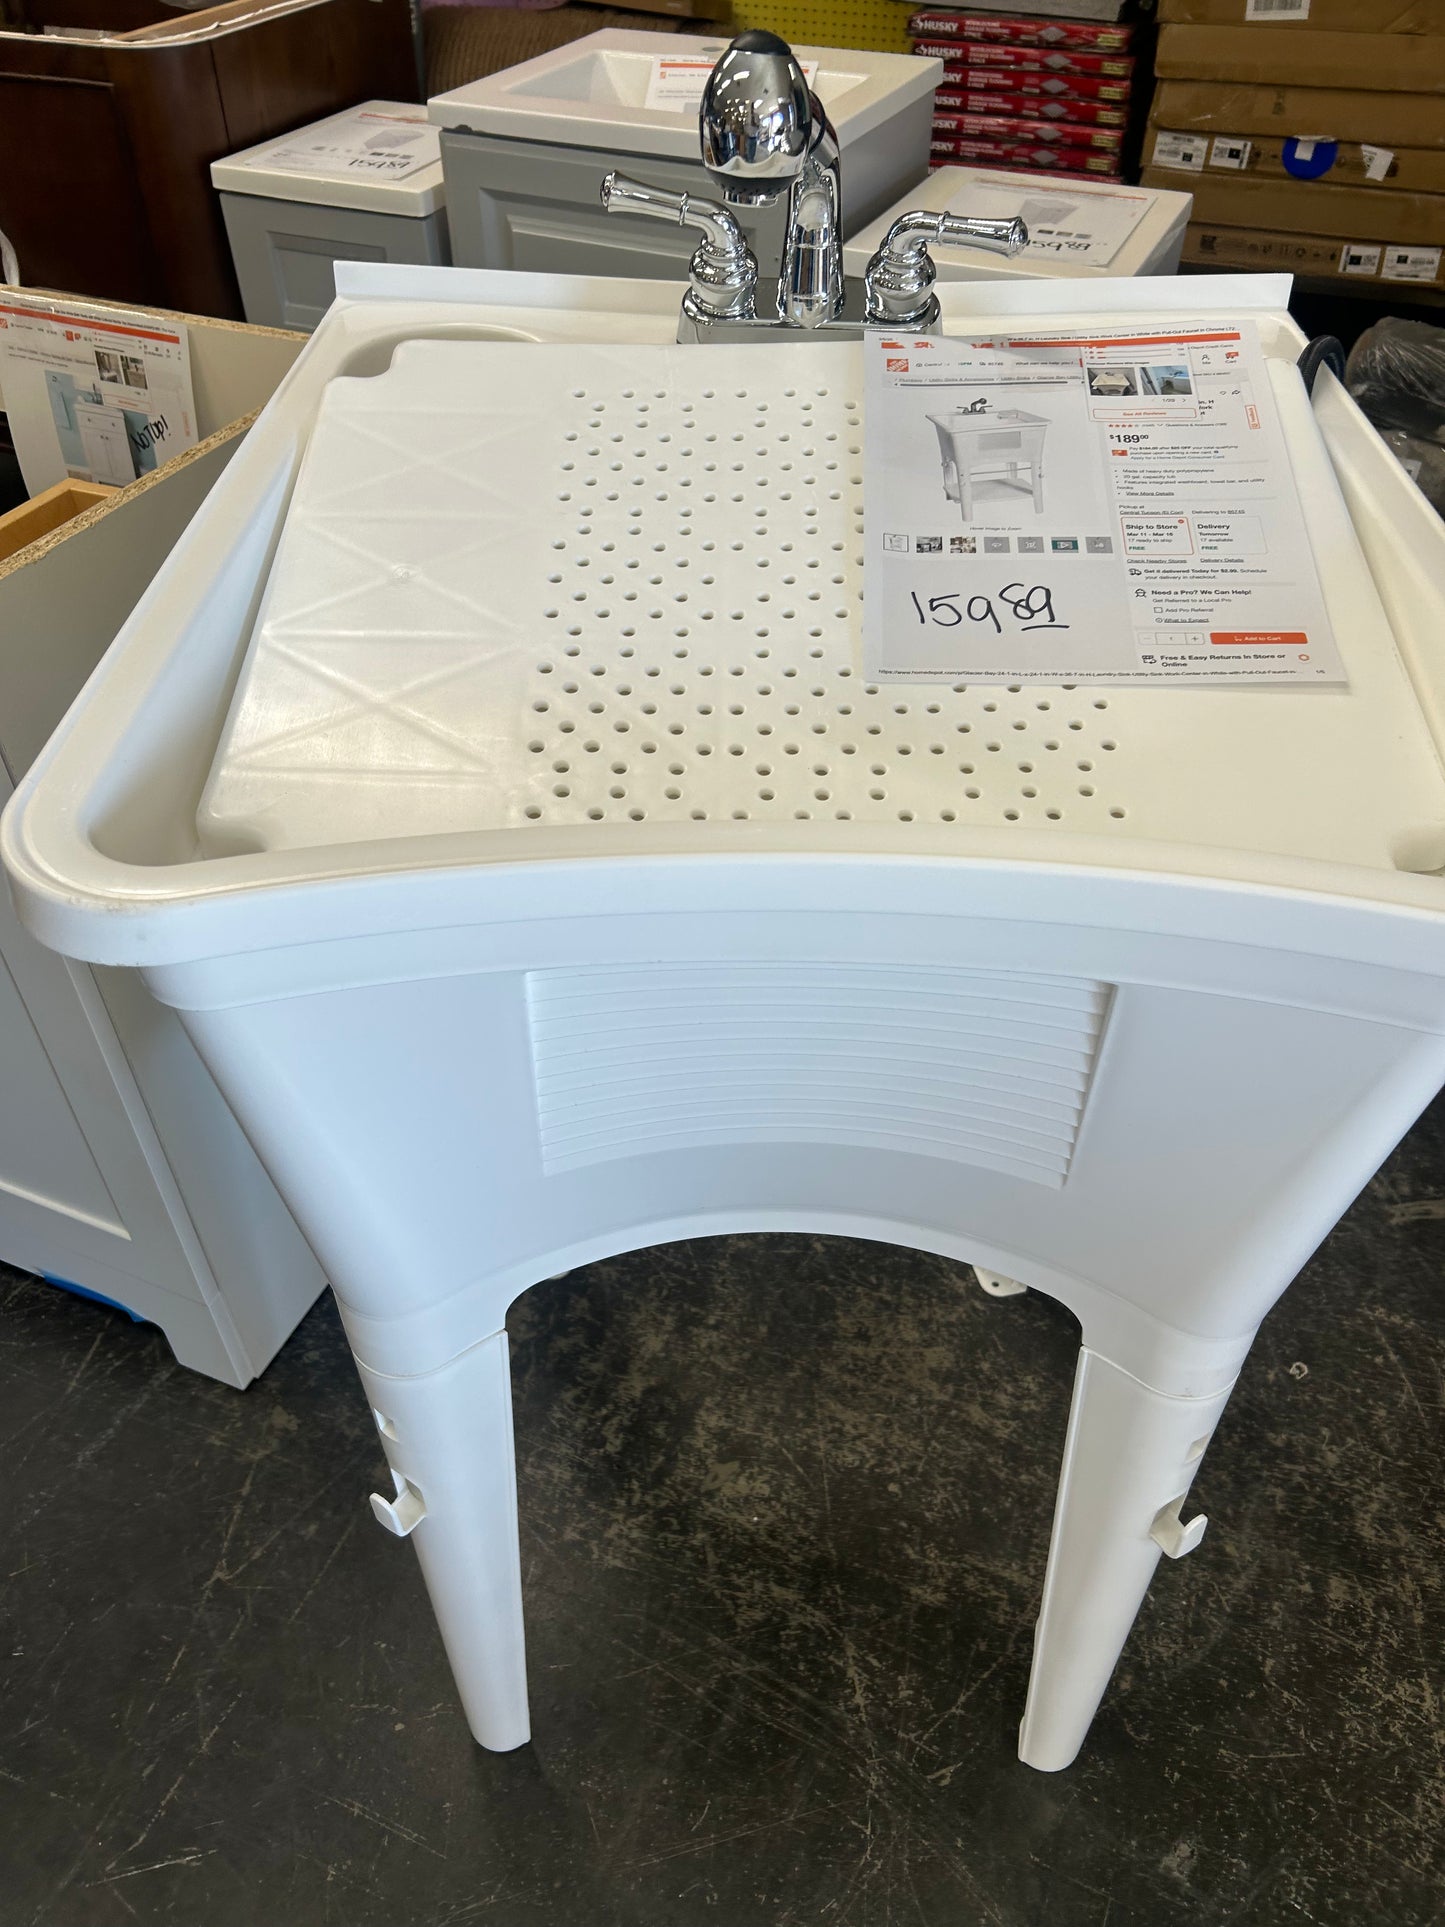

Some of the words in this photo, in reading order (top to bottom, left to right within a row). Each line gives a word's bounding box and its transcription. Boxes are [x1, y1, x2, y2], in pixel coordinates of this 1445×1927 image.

[924, 20, 959, 32] HUSKY
[928, 46, 963, 58] HUSKY
[943, 72, 962, 83] SKY
[935, 96, 962, 106] USKY
[1188, 654, 1208, 662] Easy
